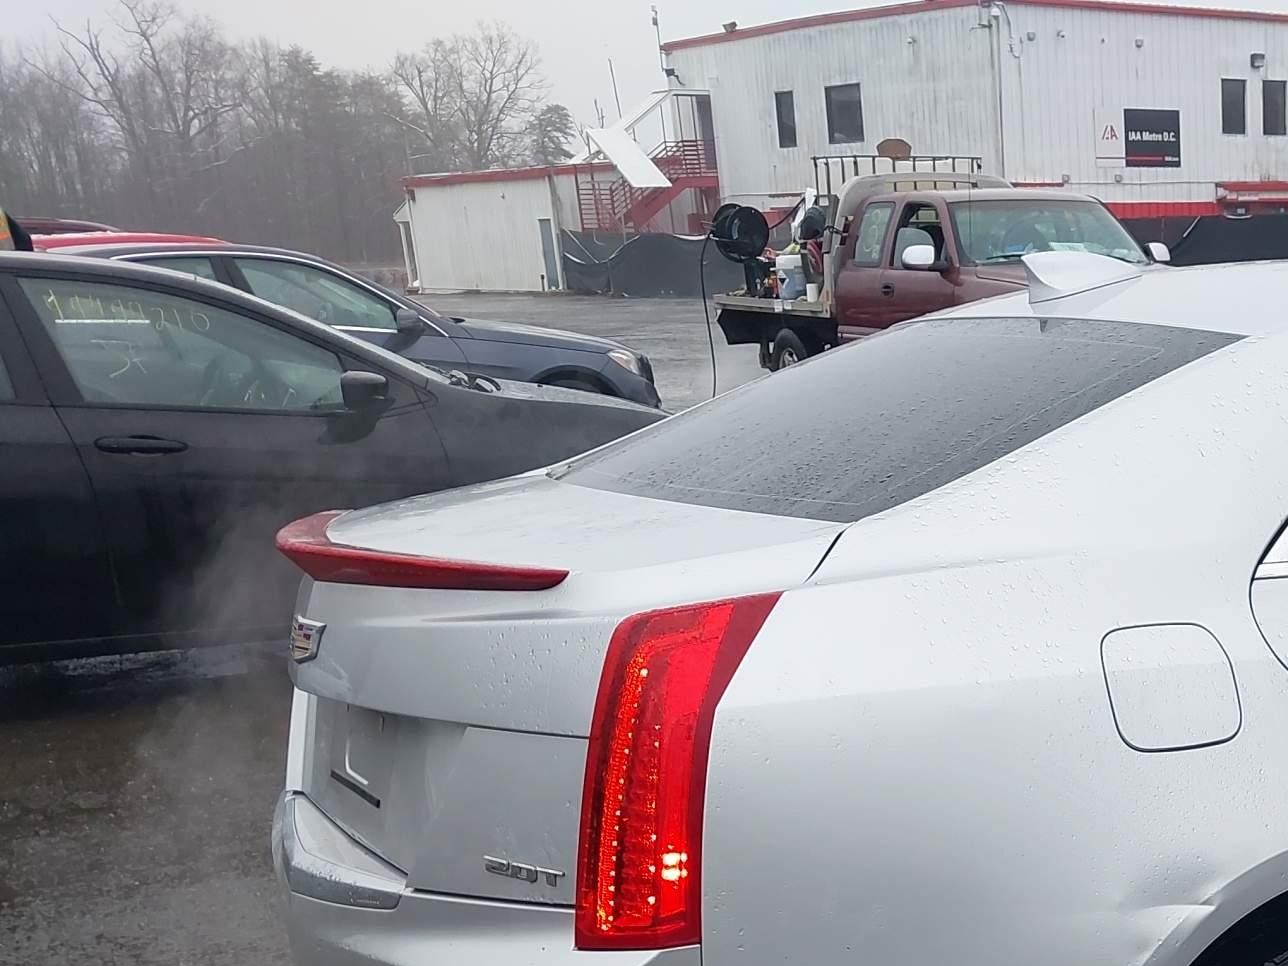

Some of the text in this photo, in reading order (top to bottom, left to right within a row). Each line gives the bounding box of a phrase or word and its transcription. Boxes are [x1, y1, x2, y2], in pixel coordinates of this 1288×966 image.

[1128, 130, 1177, 142] IAA Metro D.C.
